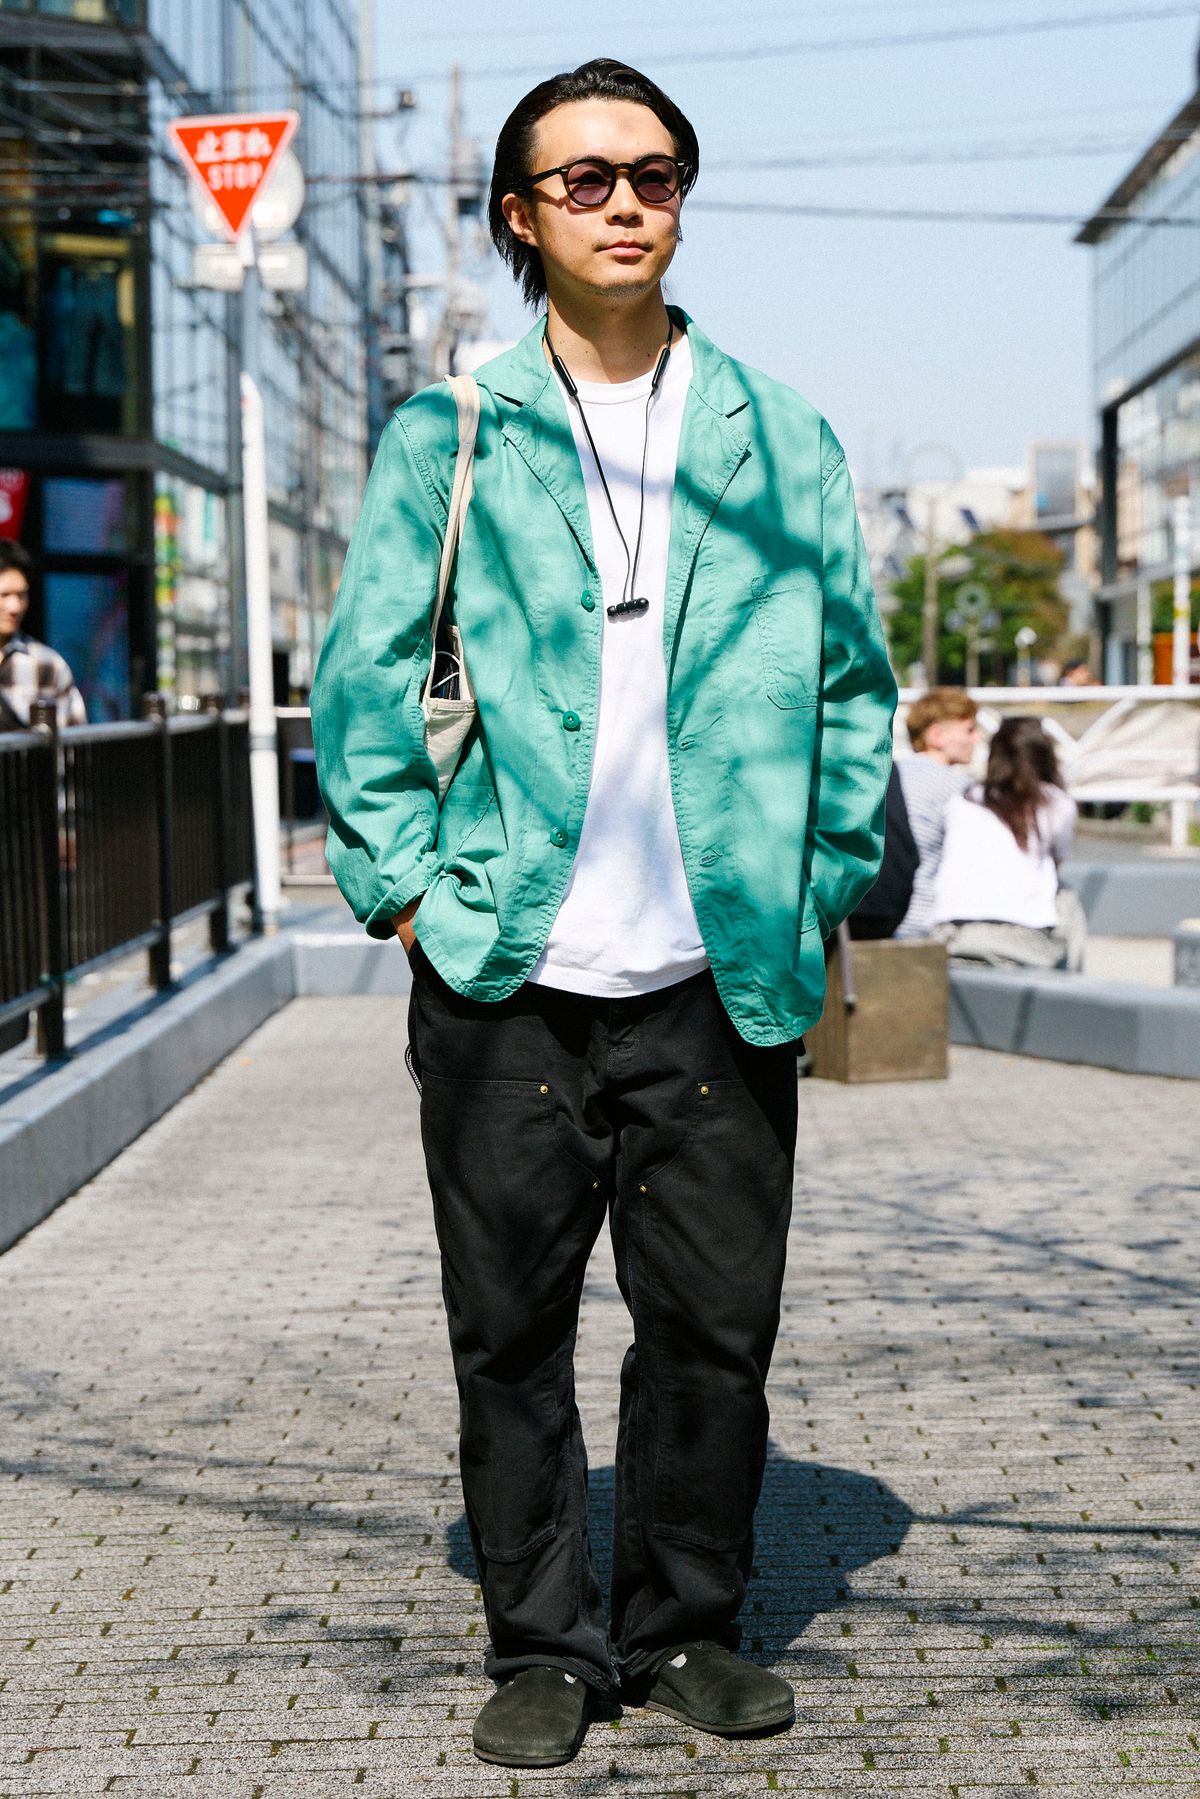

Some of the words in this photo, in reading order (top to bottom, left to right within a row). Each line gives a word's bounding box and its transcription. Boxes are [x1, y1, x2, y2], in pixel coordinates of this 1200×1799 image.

[194, 128, 272, 163] 止まれ
[207, 161, 263, 190] STOP
